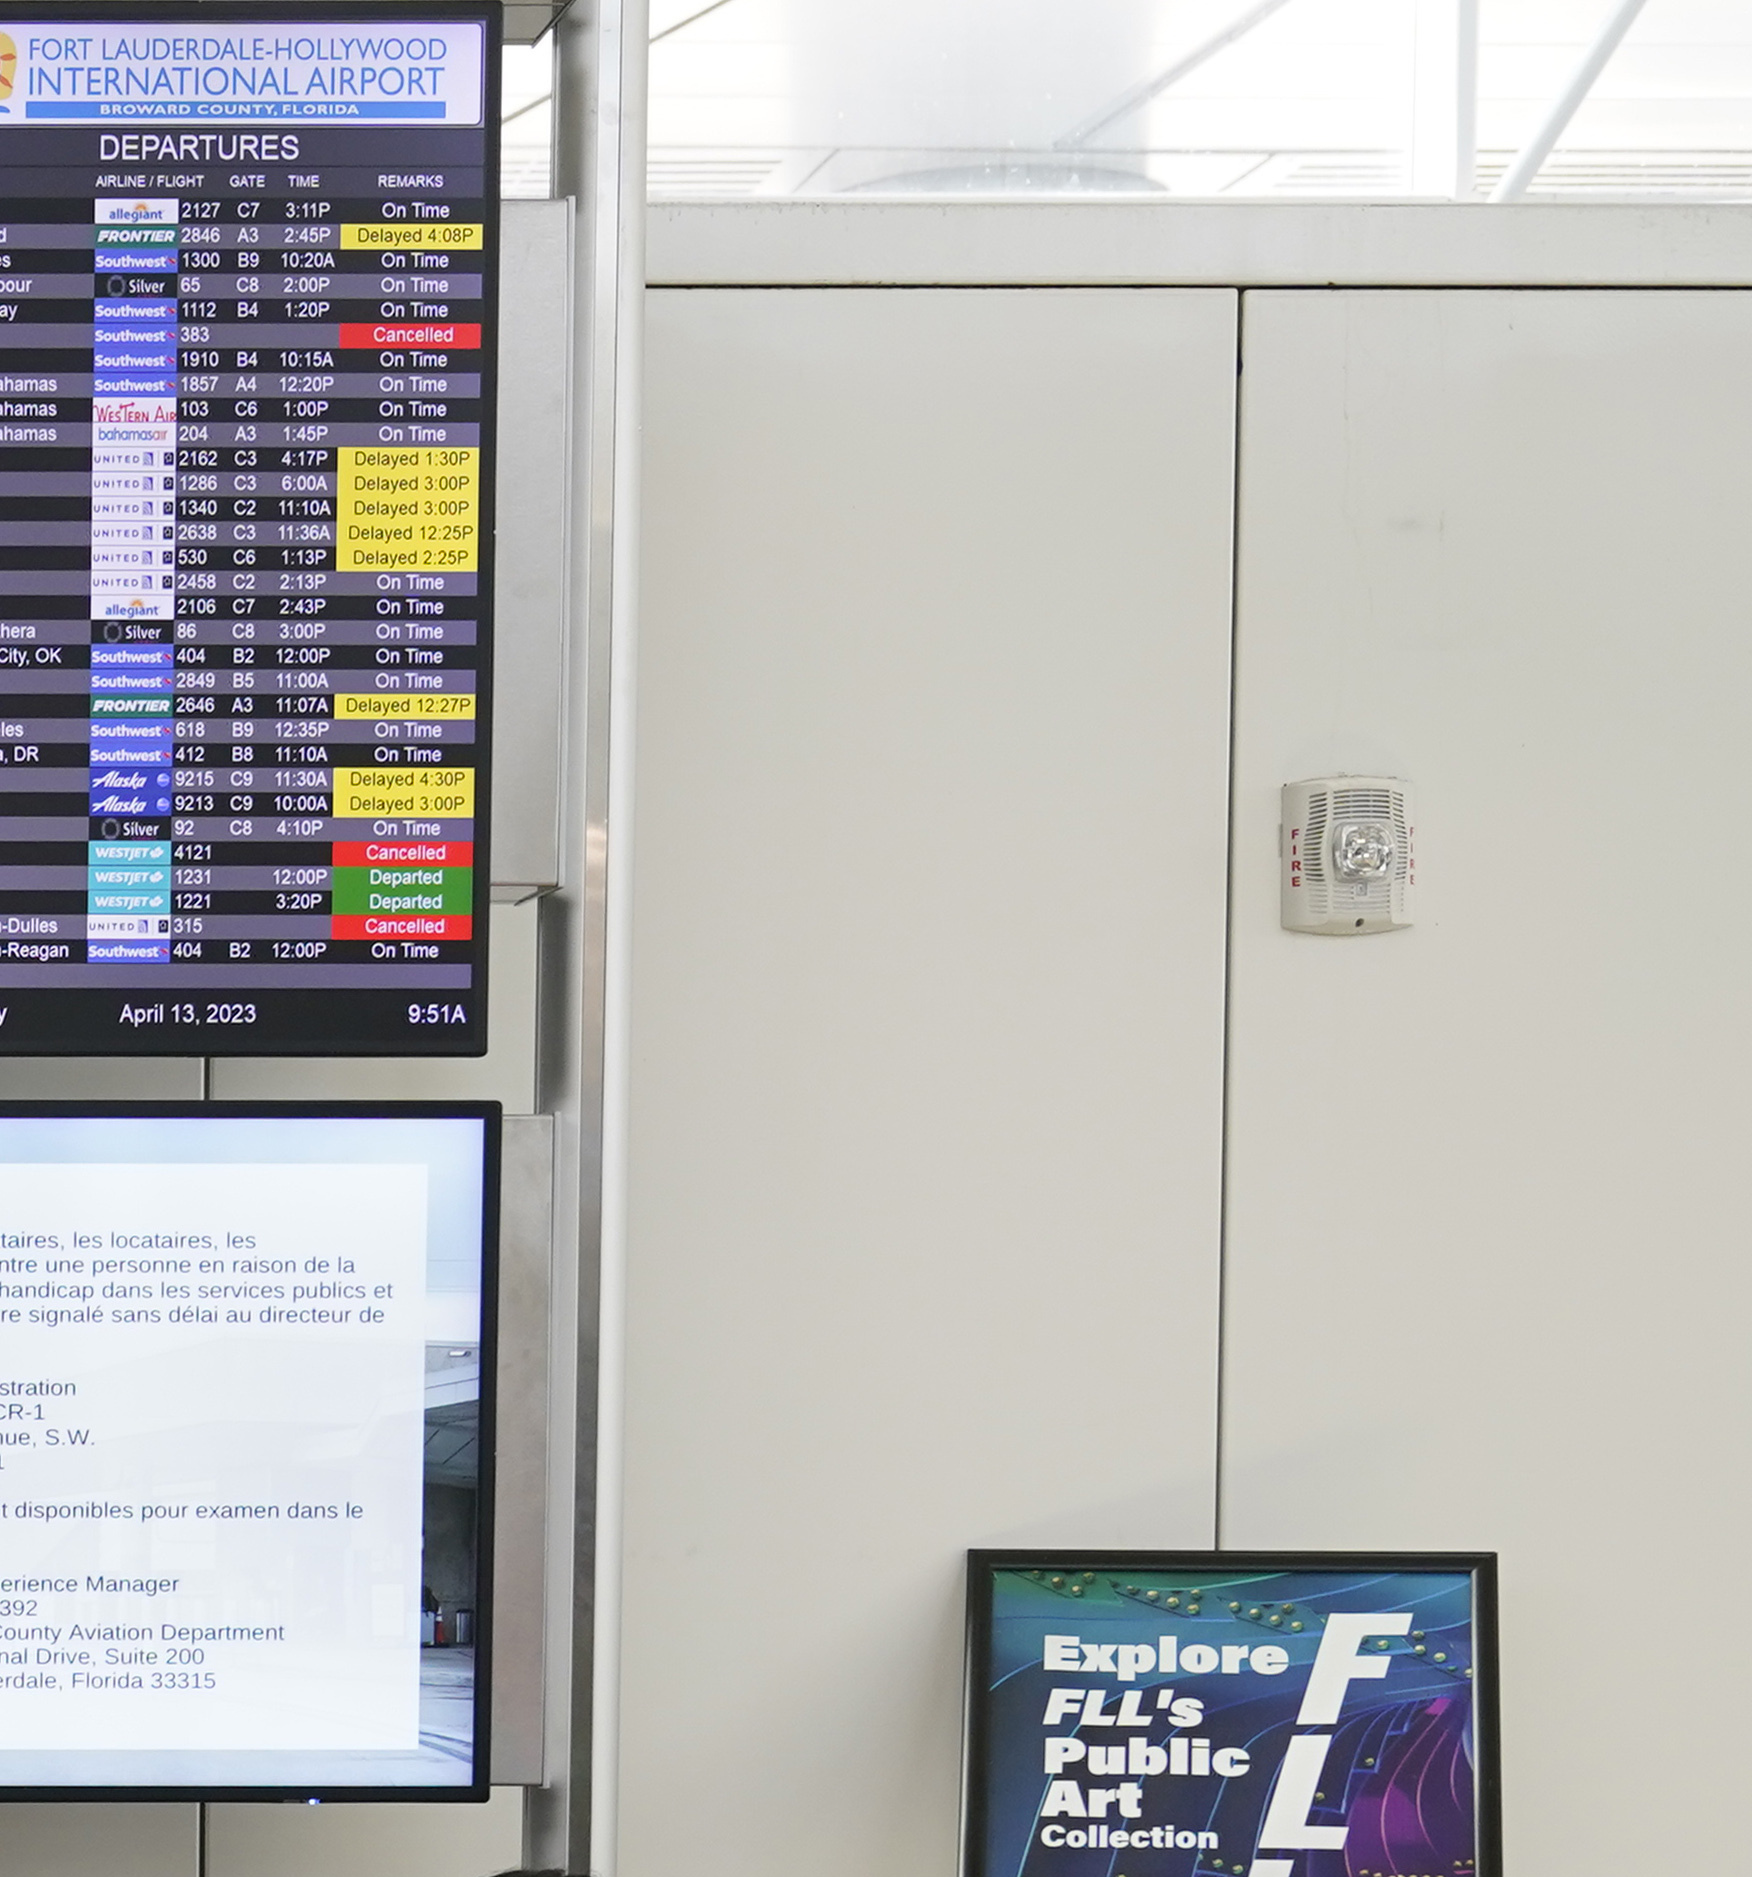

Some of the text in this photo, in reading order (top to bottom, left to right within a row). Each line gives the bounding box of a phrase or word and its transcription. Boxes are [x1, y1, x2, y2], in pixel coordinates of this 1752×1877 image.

[30, 38, 446, 60] FORT LAUDERDALE-HOLLYWOOD
[30, 67, 445, 95] INTERNATIONAL AIRPORT
[101, 104, 359, 117] BROWARD COUNTY, FLORIDA
[101, 135, 299, 160] DEPARTURES
[106, 209, 166, 222] allegiant
[182, 202, 220, 218] 2127
[238, 202, 260, 218] C7
[286, 202, 330, 218] 3:11P
[382, 202, 406, 218] On
[412, 202, 449, 218] Time
[1291, 828, 1301, 886] FIRE
[119, 1004, 163, 1027] April
[171, 1004, 199, 1025] 13,
[206, 1004, 256, 1023] 2023
[409, 1004, 465, 1023] 9:51A
[46, 1429, 94, 1445] S.W.
[1043, 1635, 1289, 1681] Explore
[1043, 1689, 1204, 1727] FLL's
[1044, 1738, 1250, 1776] Public
[1041, 1781, 1142, 1818] Art
[1041, 1825, 1219, 1849] Collection
